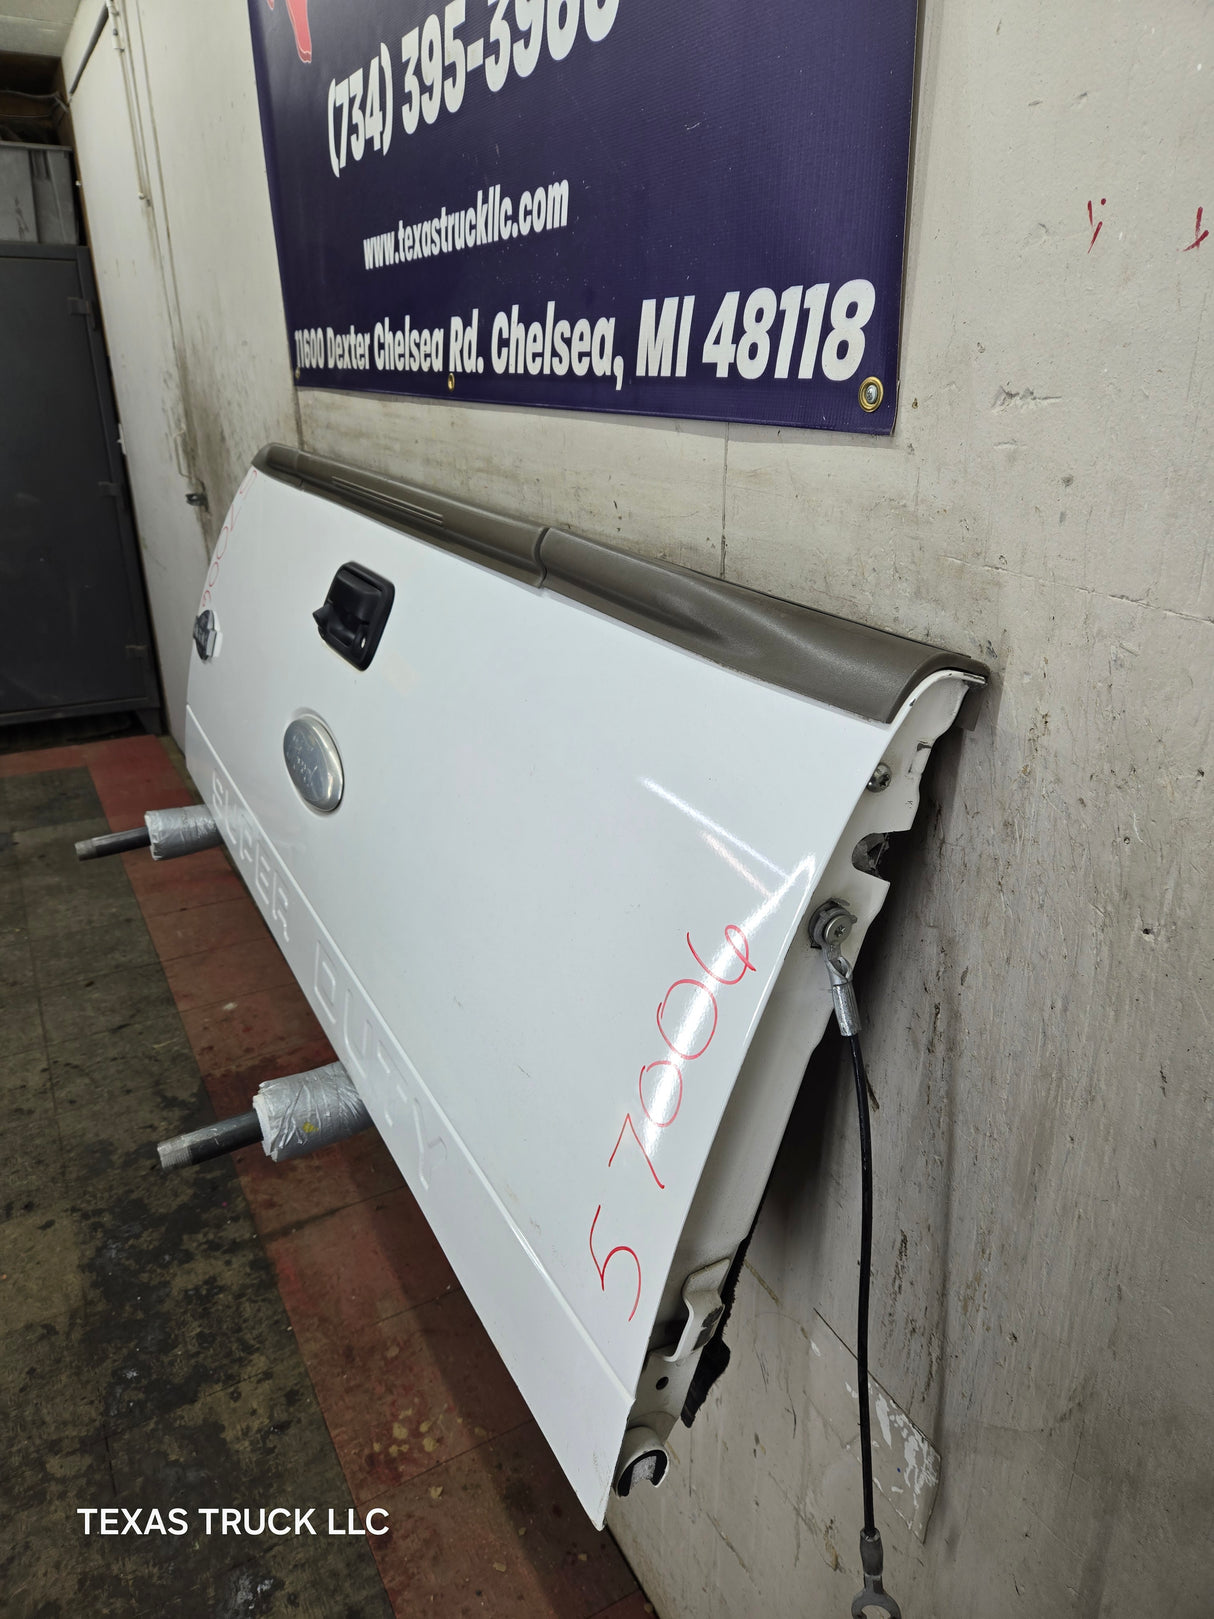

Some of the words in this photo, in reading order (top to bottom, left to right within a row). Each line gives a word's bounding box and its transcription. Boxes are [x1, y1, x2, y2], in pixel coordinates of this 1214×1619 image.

[327, 42, 393, 178] (734)
[363, 179, 569, 270] www.texastruckllc.com
[294, 327, 325, 369] 11600
[326, 325, 371, 370] Dexter
[373, 314, 445, 372] Chelsea
[449, 308, 484, 373] Rd.
[491, 301, 623, 391] Chelsea,
[635, 295, 695, 378] MI
[702, 279, 876, 381] 48118
